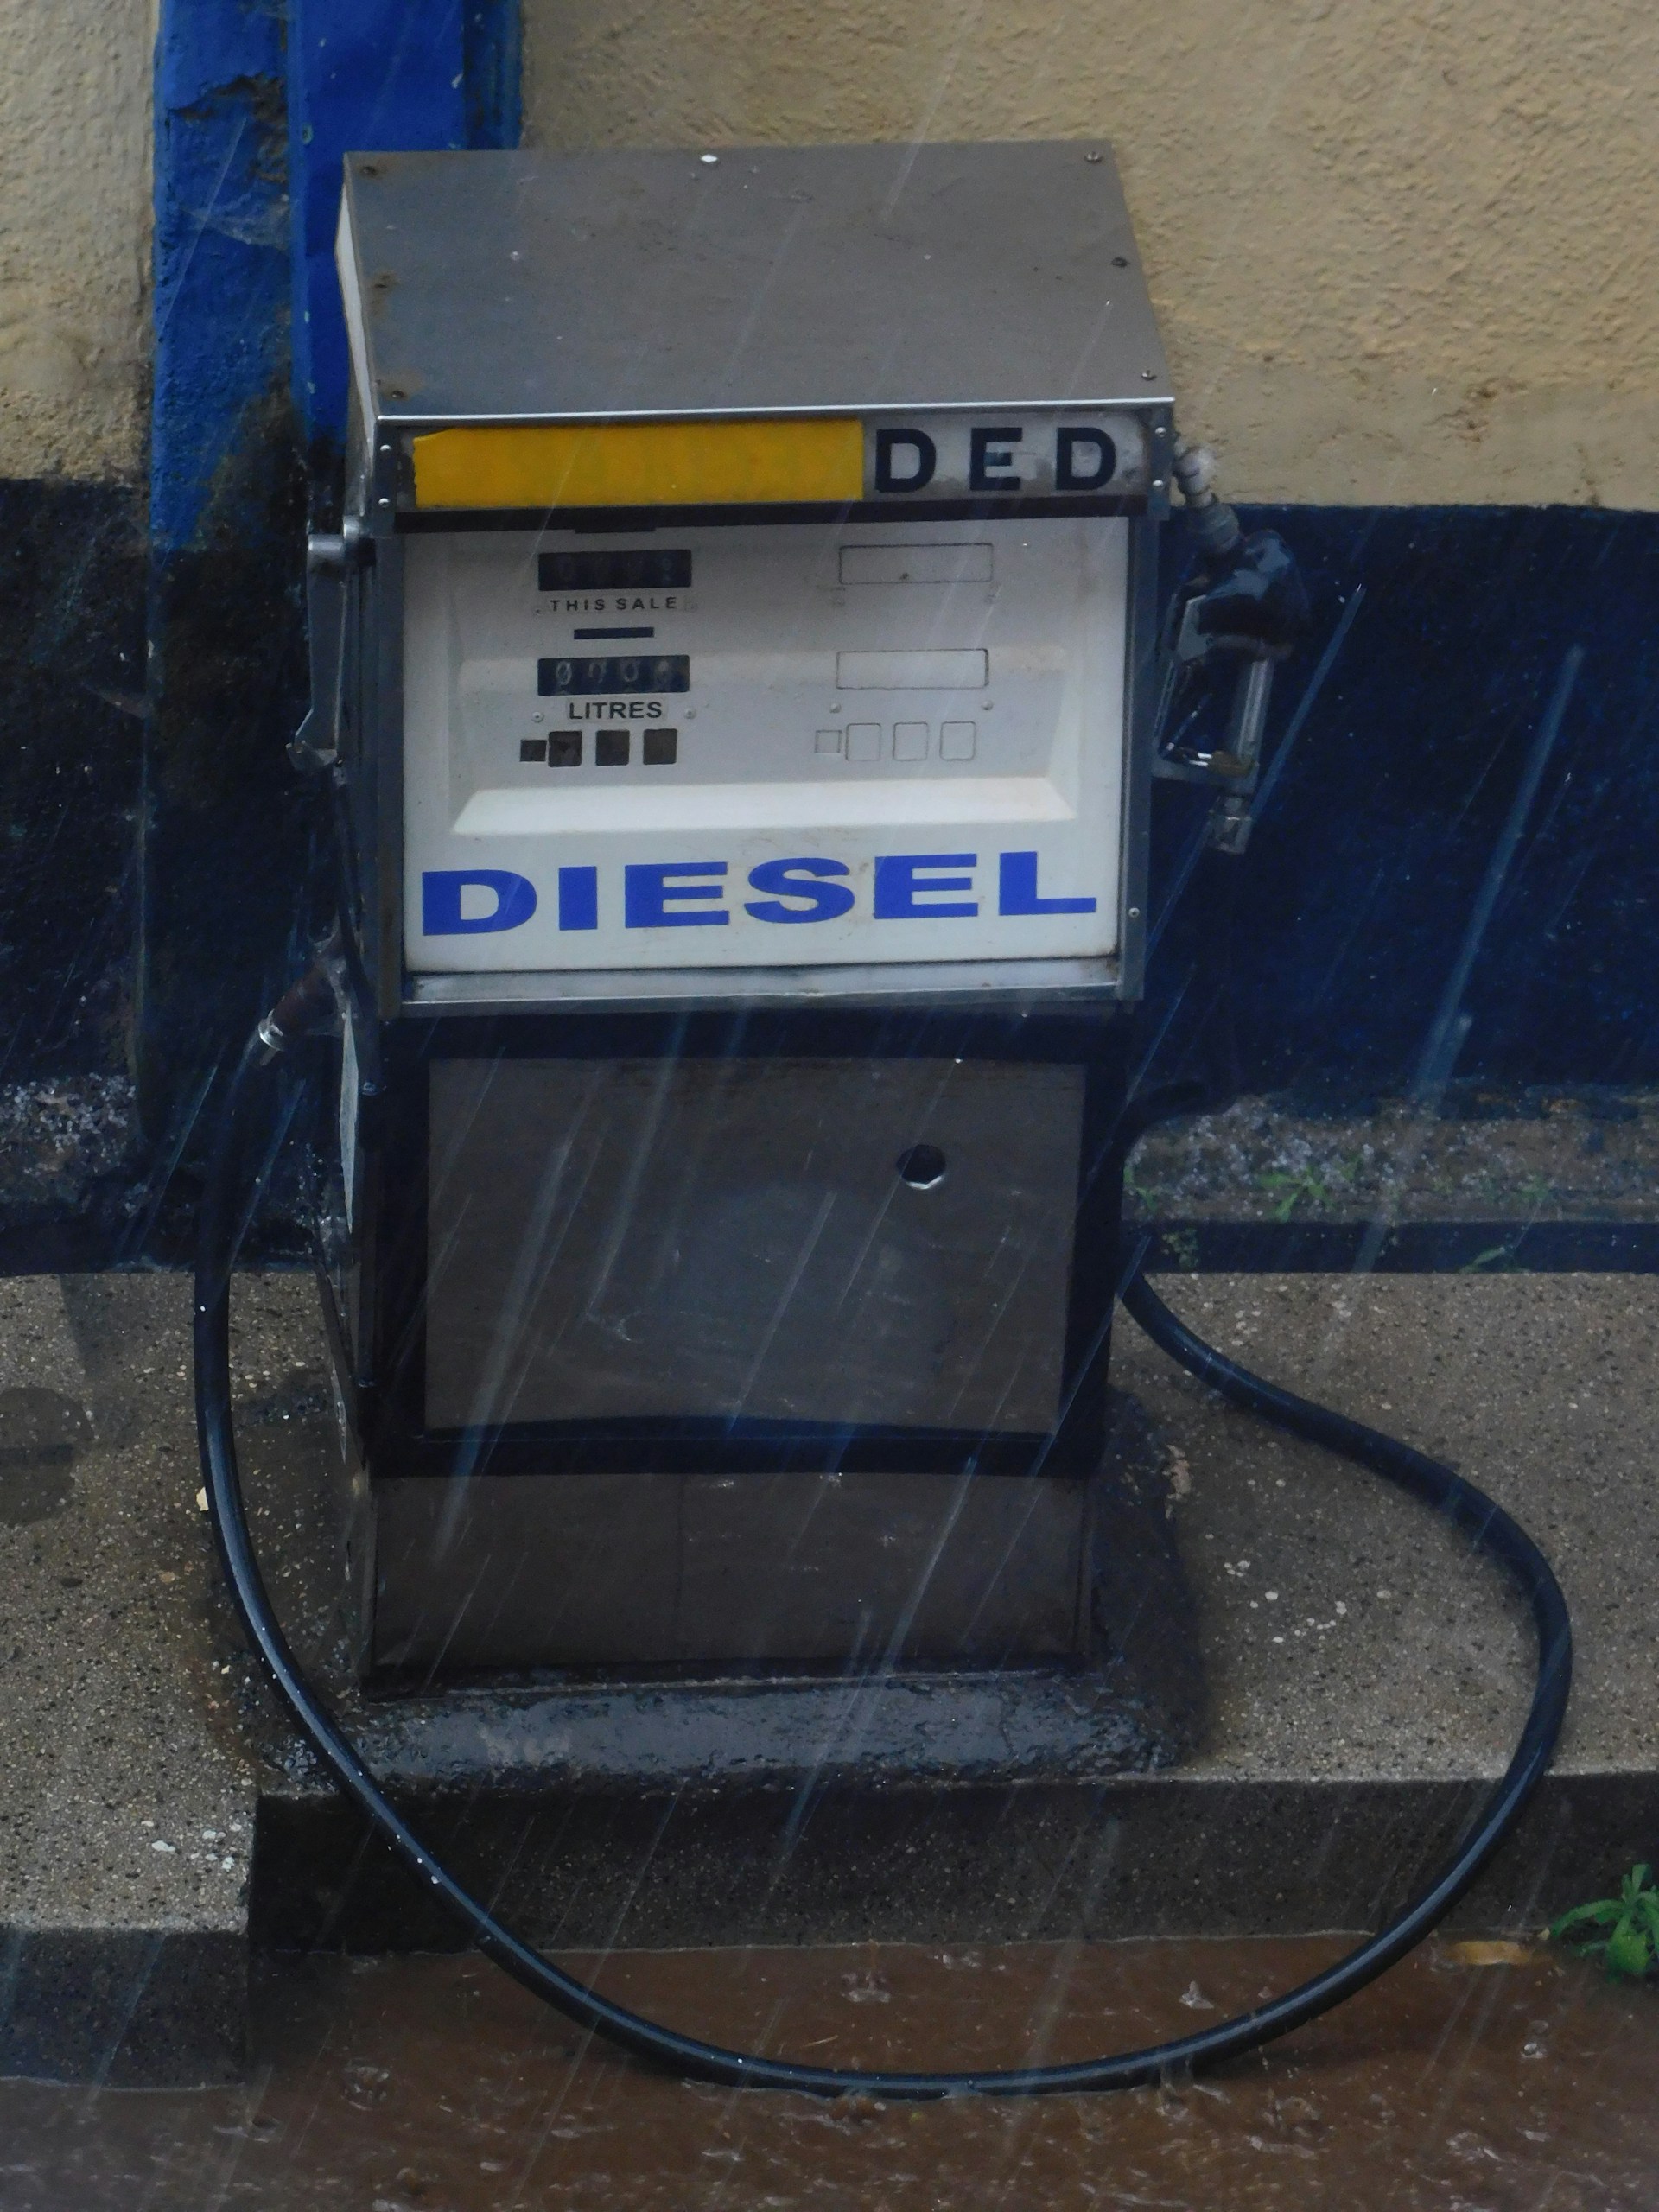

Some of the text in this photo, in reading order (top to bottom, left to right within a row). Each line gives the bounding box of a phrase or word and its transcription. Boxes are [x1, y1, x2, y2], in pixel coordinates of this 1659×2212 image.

[550, 596, 677, 613] THIS SALE
[569, 701, 663, 721] LITRES
[422, 851, 1097, 937] DIESEL
